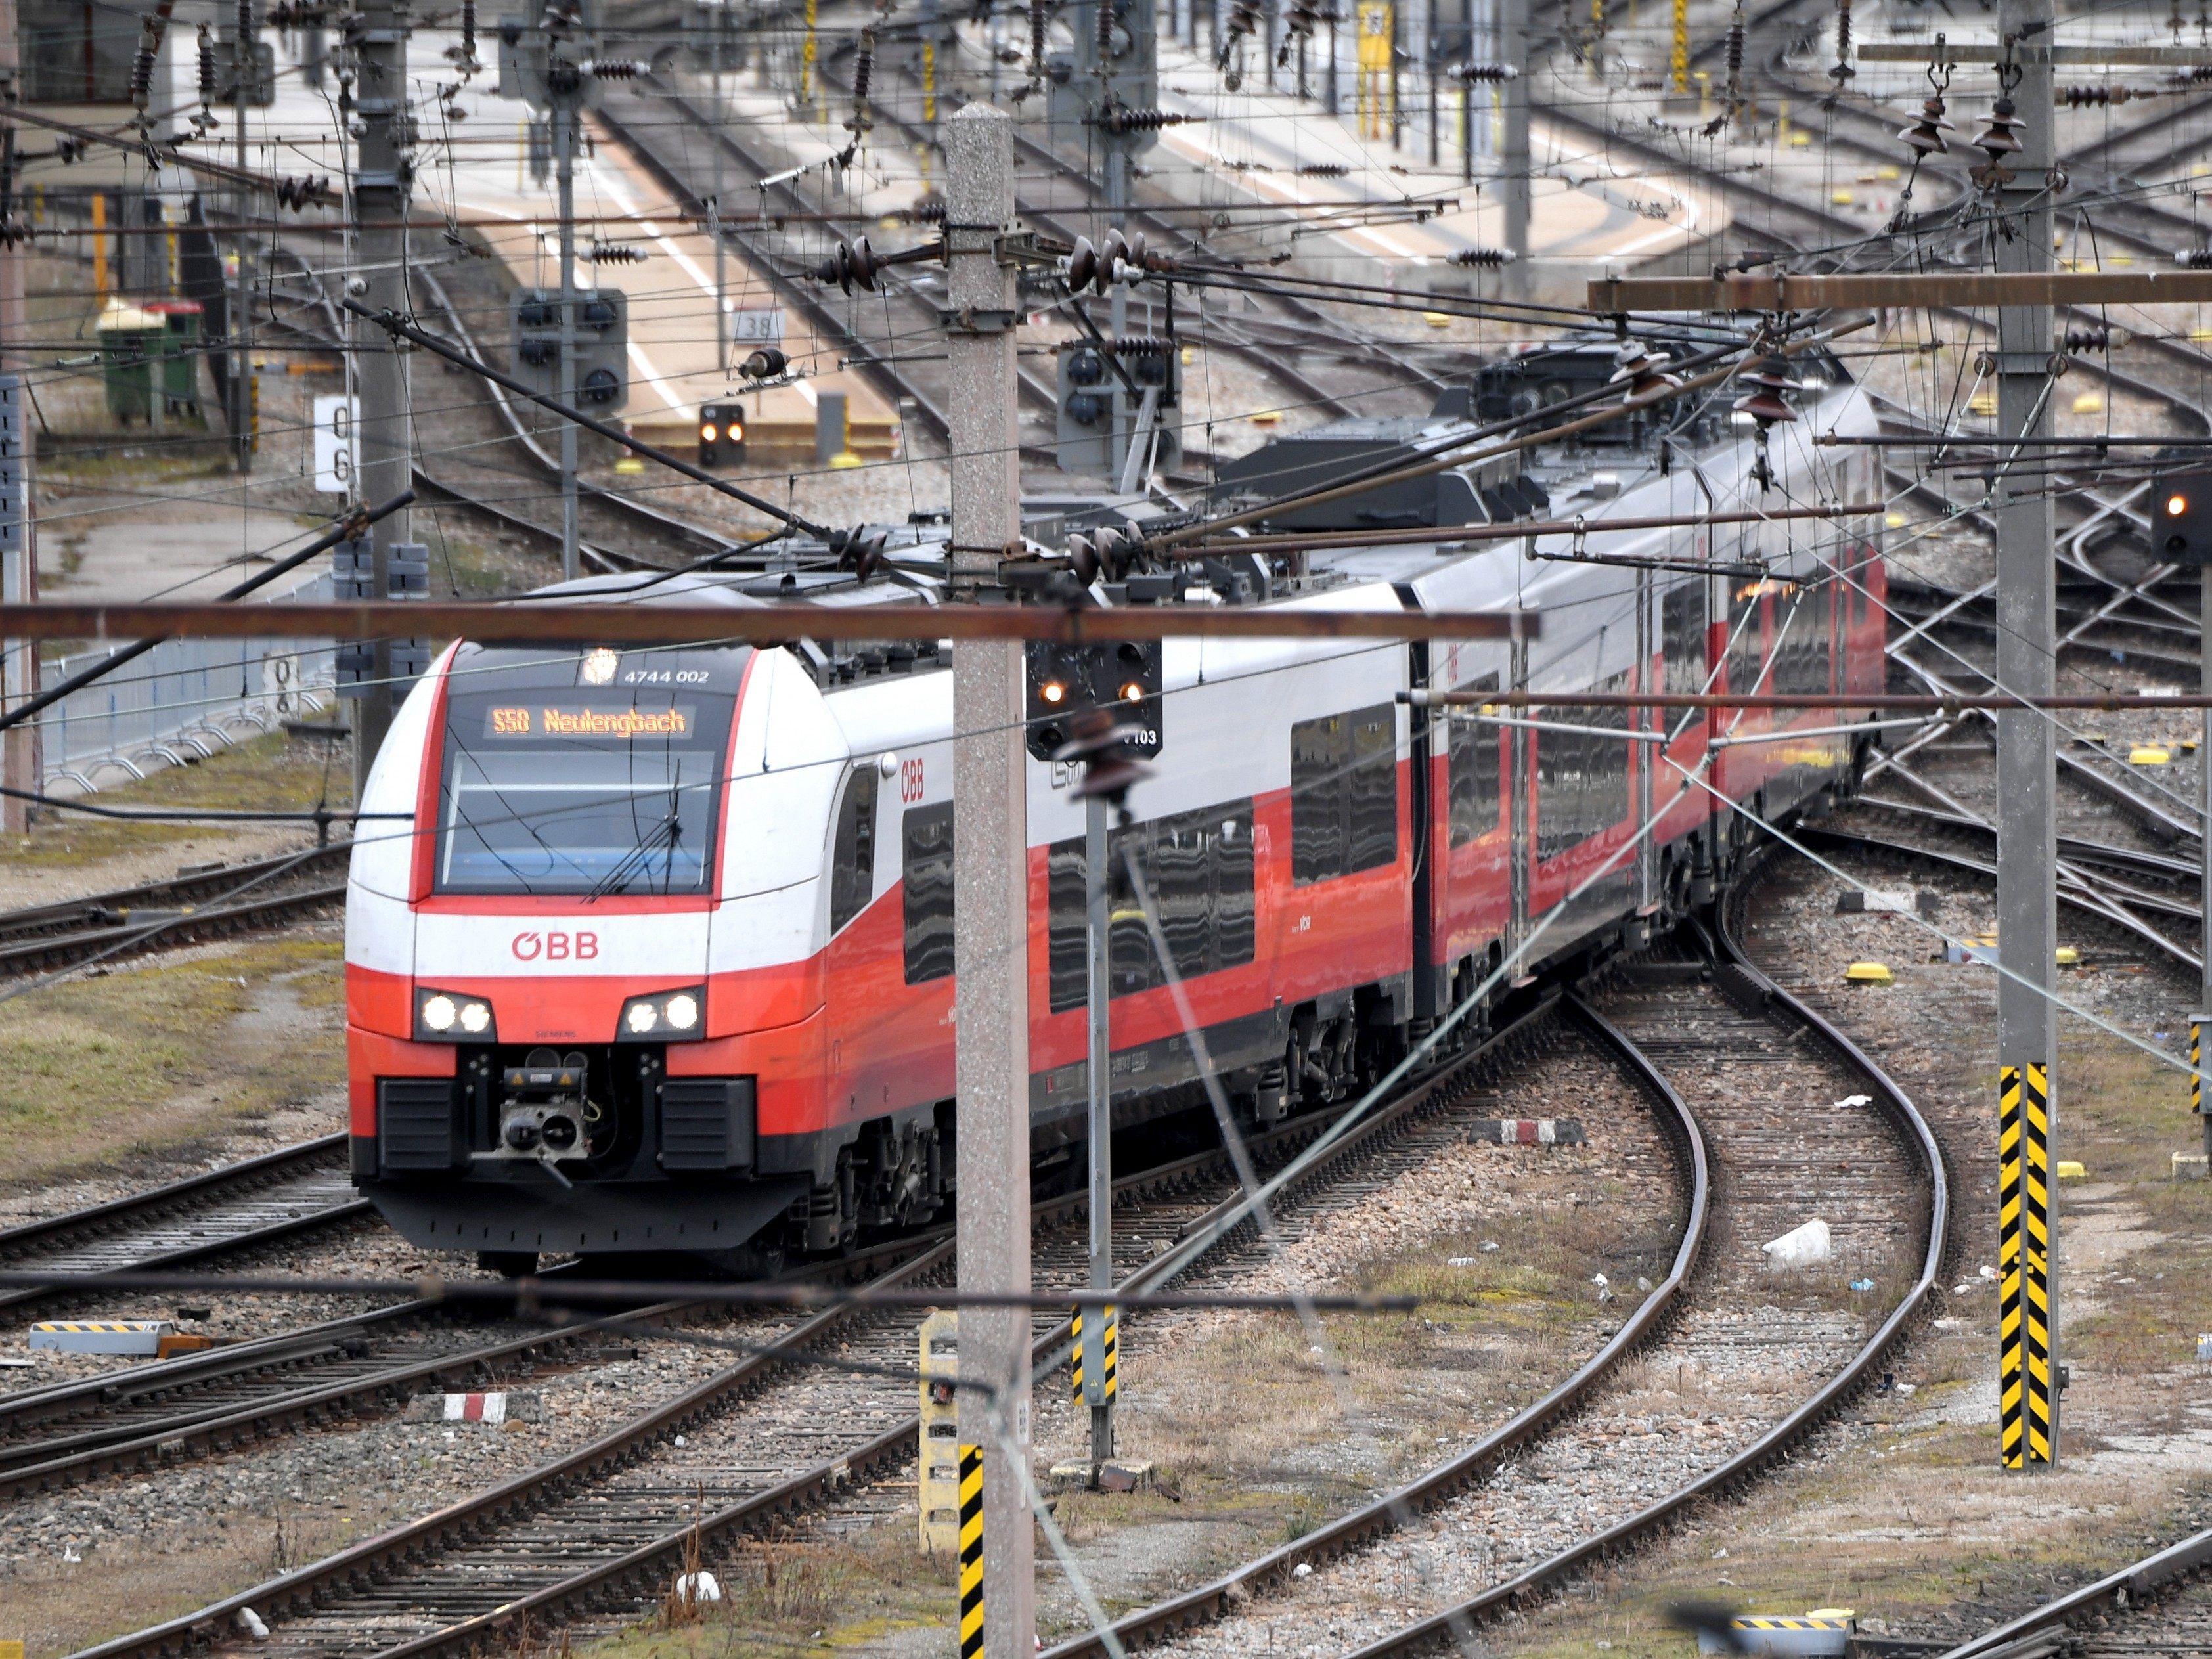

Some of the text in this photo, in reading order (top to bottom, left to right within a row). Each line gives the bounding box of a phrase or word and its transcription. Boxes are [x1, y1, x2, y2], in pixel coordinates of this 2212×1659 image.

[745, 317, 772, 338] 38
[624, 670, 710, 684] 4744 002
[493, 708, 686, 738] S50 Neulengbach
[901, 756, 924, 804] ÖBB
[512, 931, 598, 962] ÖBB
